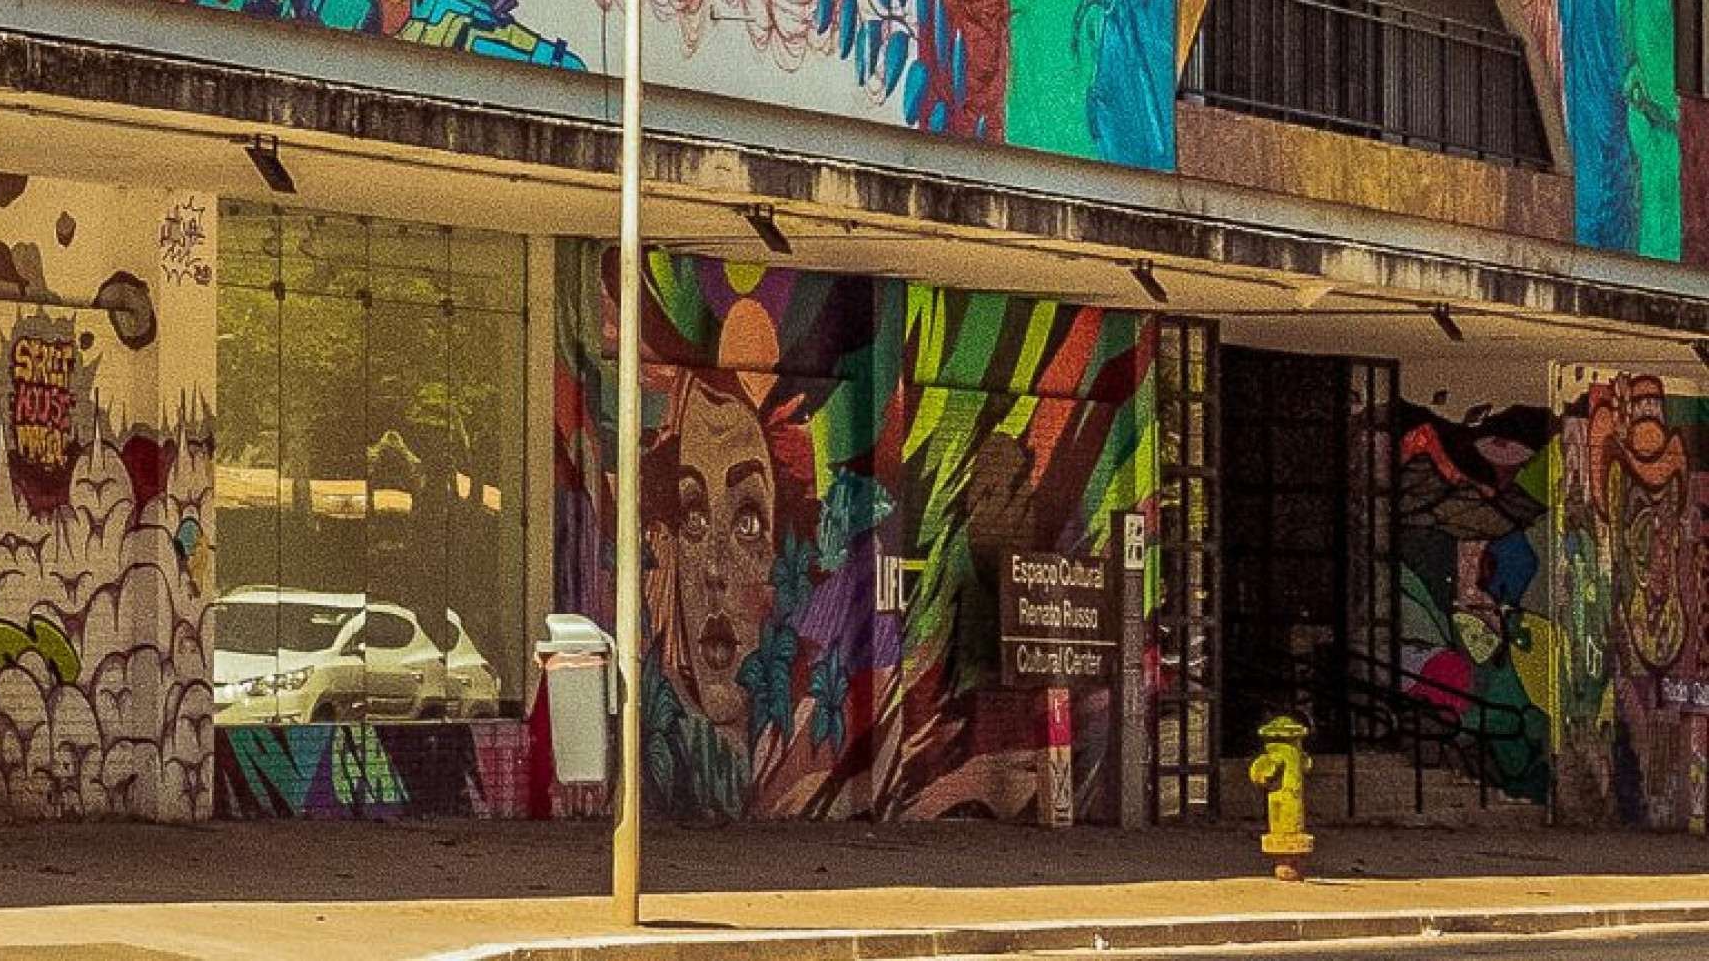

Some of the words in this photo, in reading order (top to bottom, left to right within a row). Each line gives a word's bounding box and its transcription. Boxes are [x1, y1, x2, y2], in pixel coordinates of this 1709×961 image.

[1012, 554, 1058, 592] Espaço
[1059, 557, 1105, 591] Cultural
[1019, 597, 1061, 627] Renato
[1063, 599, 1098, 629] Russo
[1016, 644, 1062, 673] Cultural
[1064, 646, 1102, 675] Center
